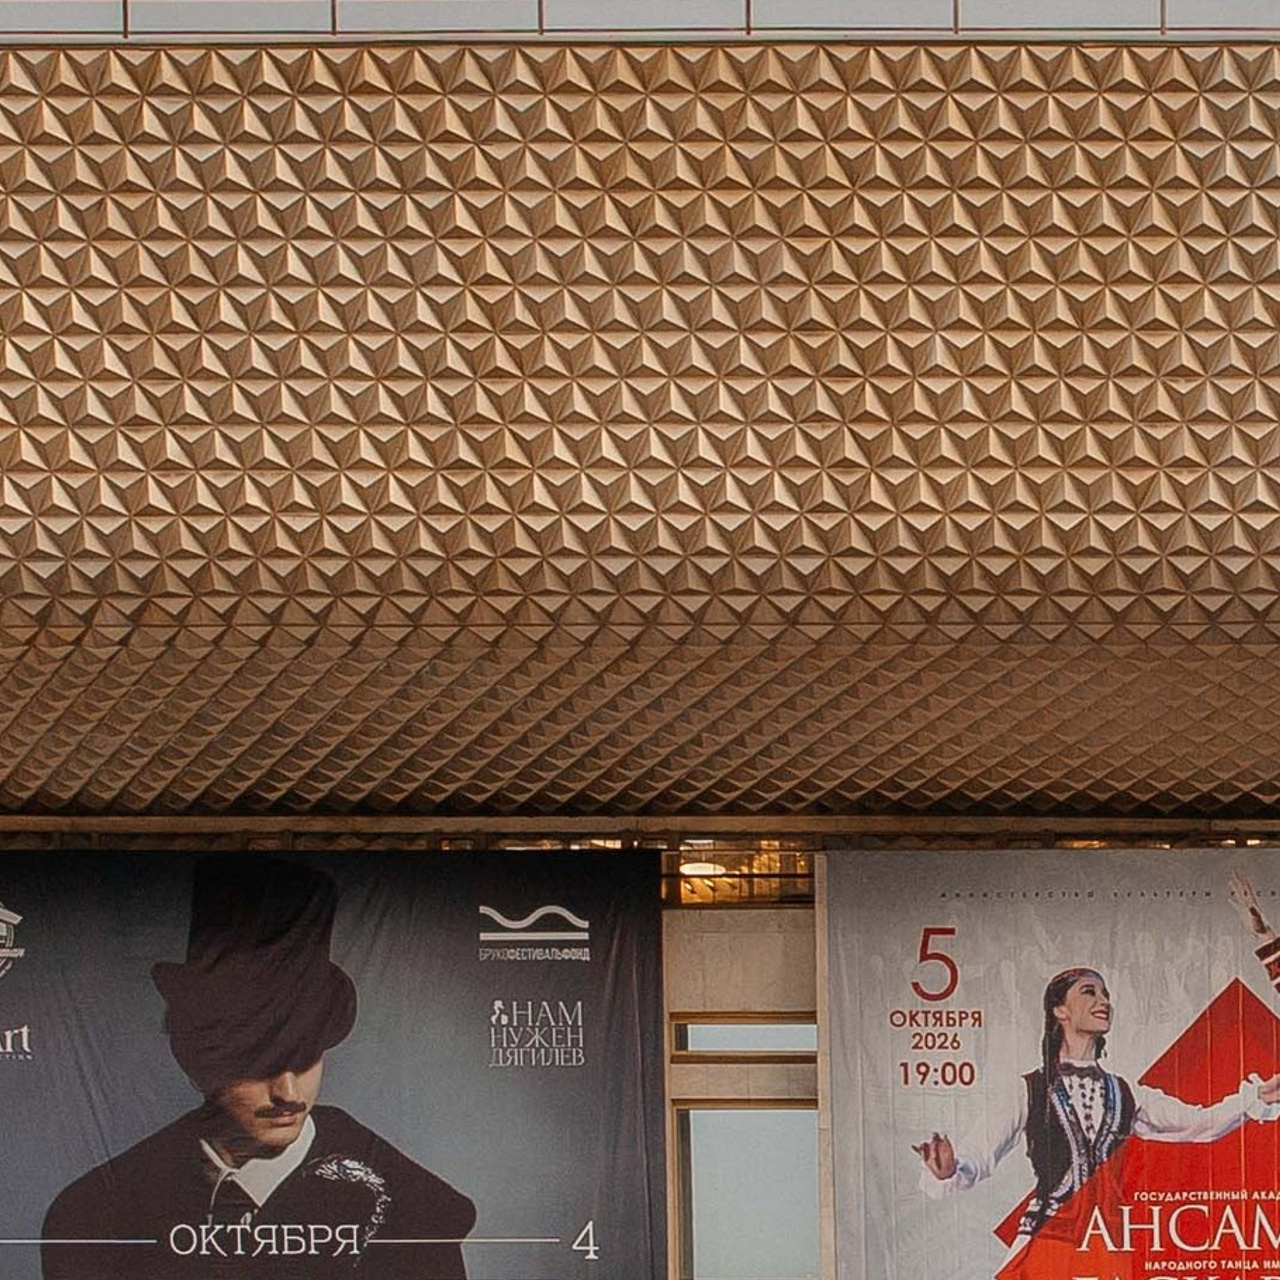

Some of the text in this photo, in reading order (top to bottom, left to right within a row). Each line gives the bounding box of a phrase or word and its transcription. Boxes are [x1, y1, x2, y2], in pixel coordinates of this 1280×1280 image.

[911, 926, 959, 1001] 5
[512, 1000, 583, 1026] НАМ
[889, 1009, 983, 1028] ОКТЯБРЯ
[0, 1024, 32, 1053] rt
[490, 1026, 584, 1048] НУЖЕН
[911, 1032, 961, 1051] 2026
[488, 1047, 585, 1068] ДЯГИЛЕВ
[899, 1061, 976, 1086] 19:00
[1134, 1189, 1248, 1202] ГОСУДАРСТВЕННЫЙ
[170, 1220, 600, 1260] ОКТЯБРЯ 4
[1145, 1260, 1218, 1270] НАРОДНОГО
[1221, 1259, 1259, 1271] ТАНЦА
